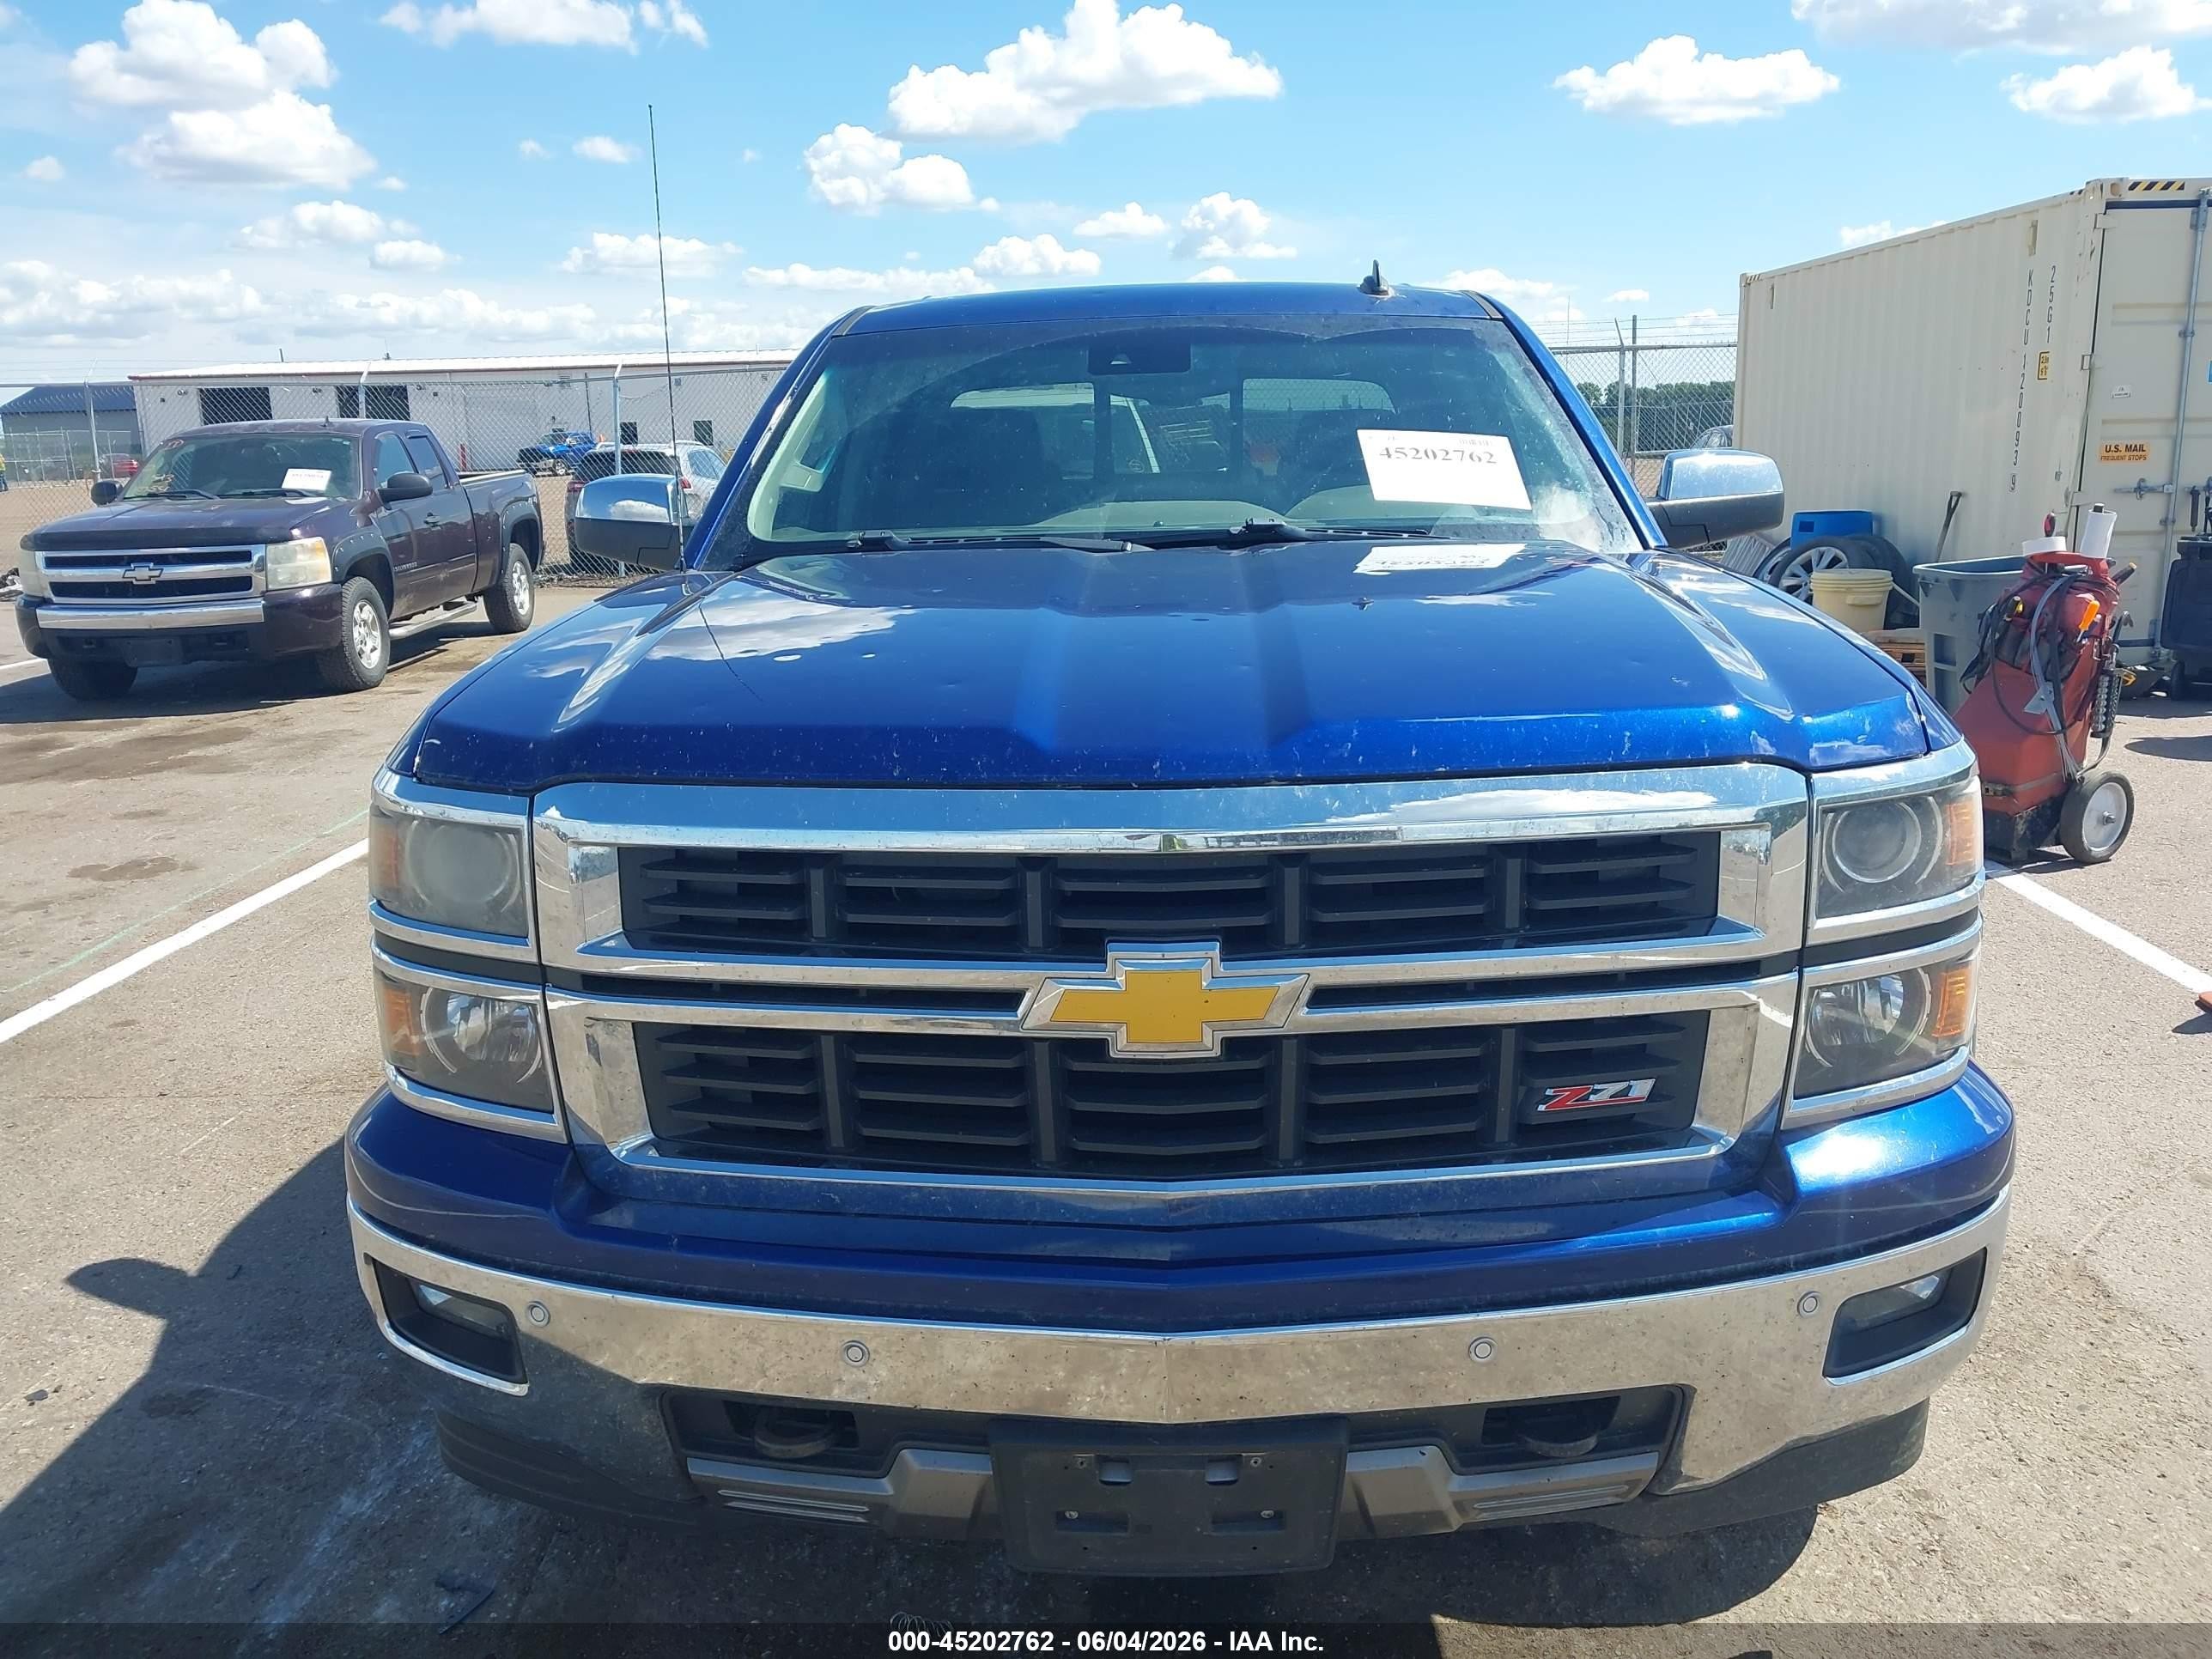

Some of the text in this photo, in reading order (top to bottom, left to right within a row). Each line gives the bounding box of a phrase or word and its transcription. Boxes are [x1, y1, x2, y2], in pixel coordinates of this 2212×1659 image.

[2023, 268, 2034, 345] KDCU
[2046, 264, 2057, 343] 25G1
[2014, 352, 2027, 466] 120093
[1378, 447, 1498, 464] 45202762
[2105, 444, 2146, 453] U.S. MAIL
[1537, 1079, 1656, 1111] Z71
